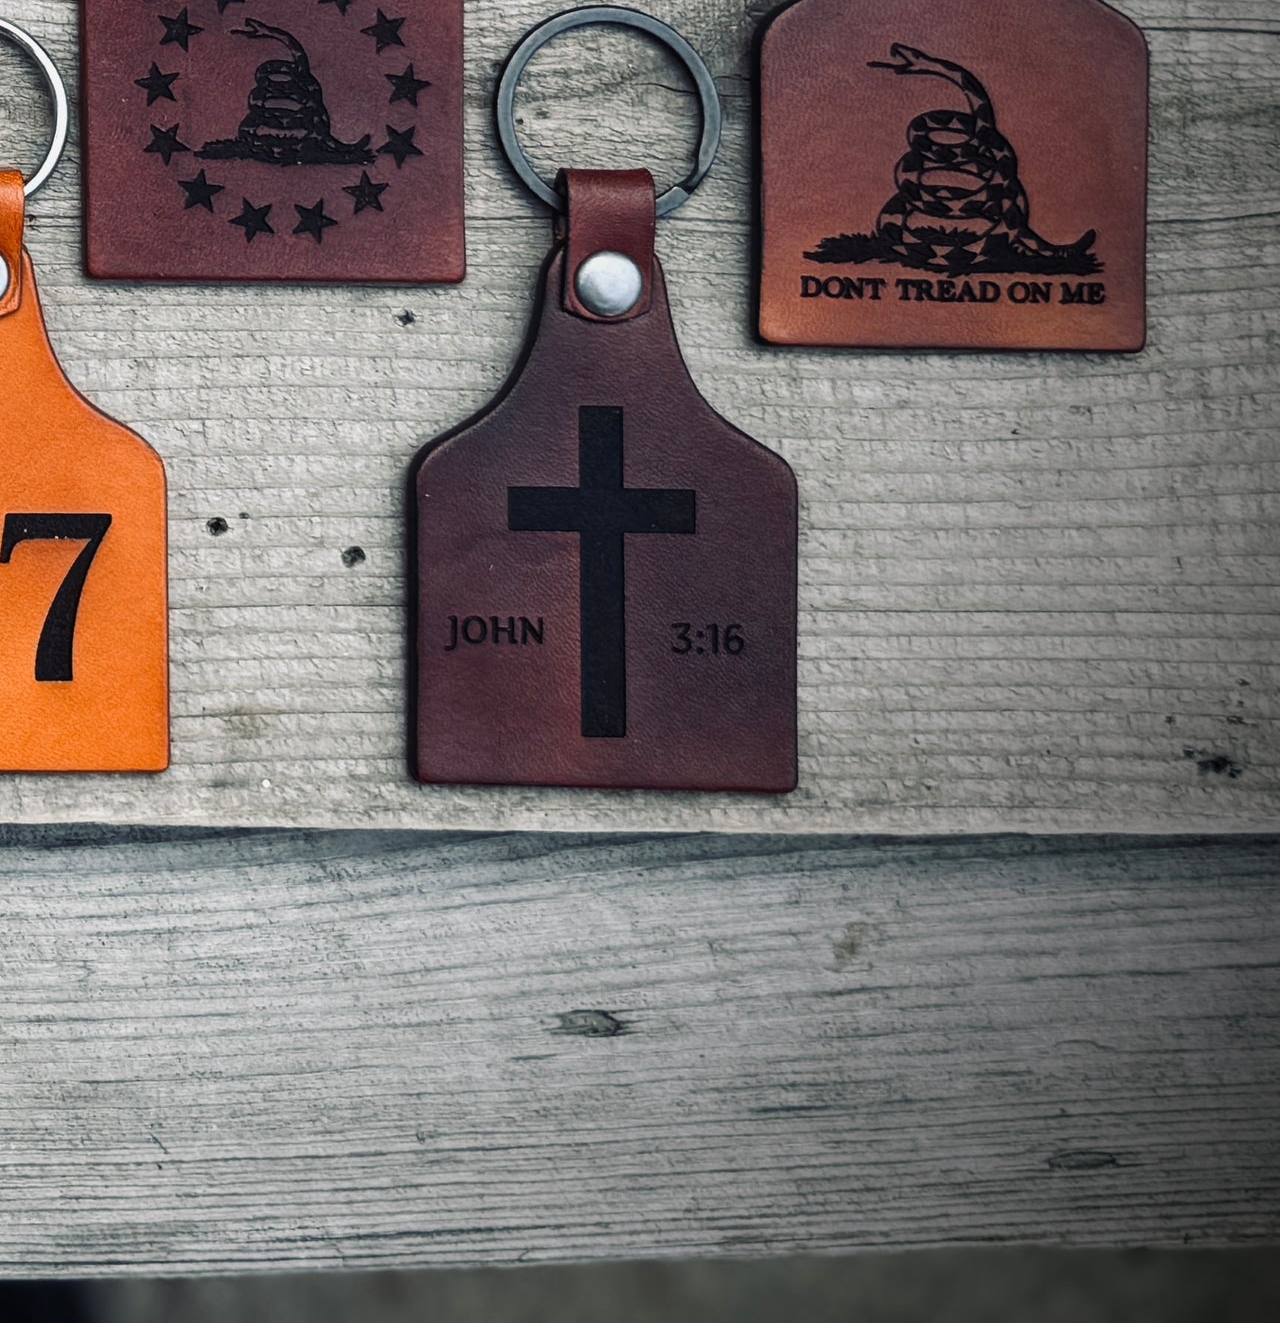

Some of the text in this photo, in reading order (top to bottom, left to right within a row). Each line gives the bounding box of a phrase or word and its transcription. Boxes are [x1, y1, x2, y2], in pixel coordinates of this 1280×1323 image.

[800, 275, 1105, 305] DONT TREAD ON ME
[444, 615, 745, 656] JOHN 3:16
